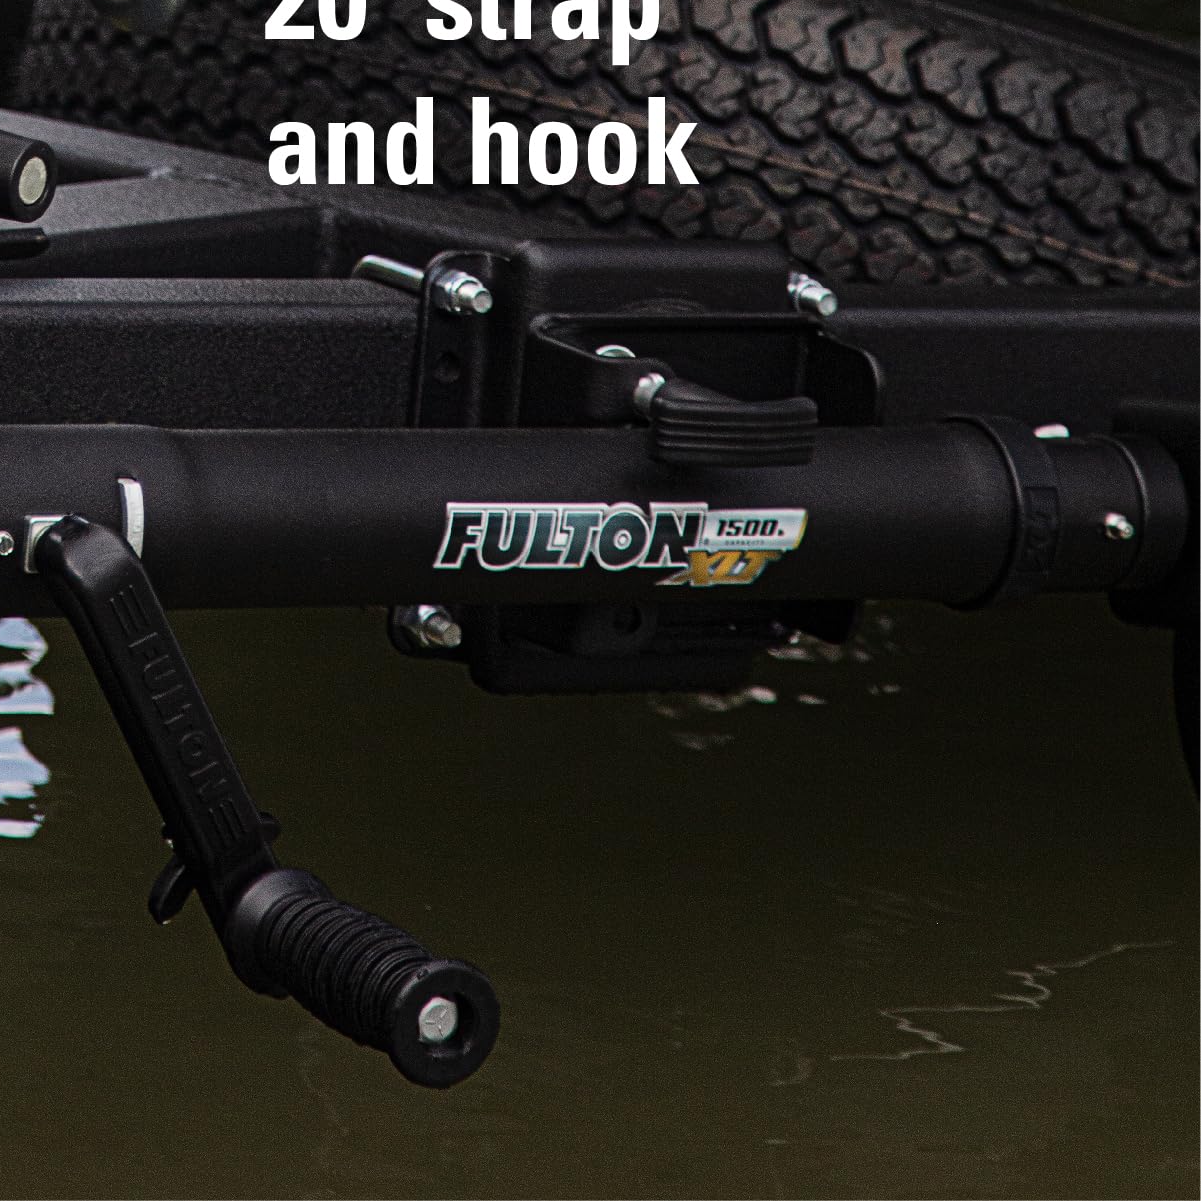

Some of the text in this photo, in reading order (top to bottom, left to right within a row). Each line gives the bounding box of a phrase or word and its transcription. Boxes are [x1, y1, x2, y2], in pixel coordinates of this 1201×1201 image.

[433, 502, 708, 571] FULTON
[655, 549, 783, 587] XLT
[129, 631, 229, 803] FULTON
